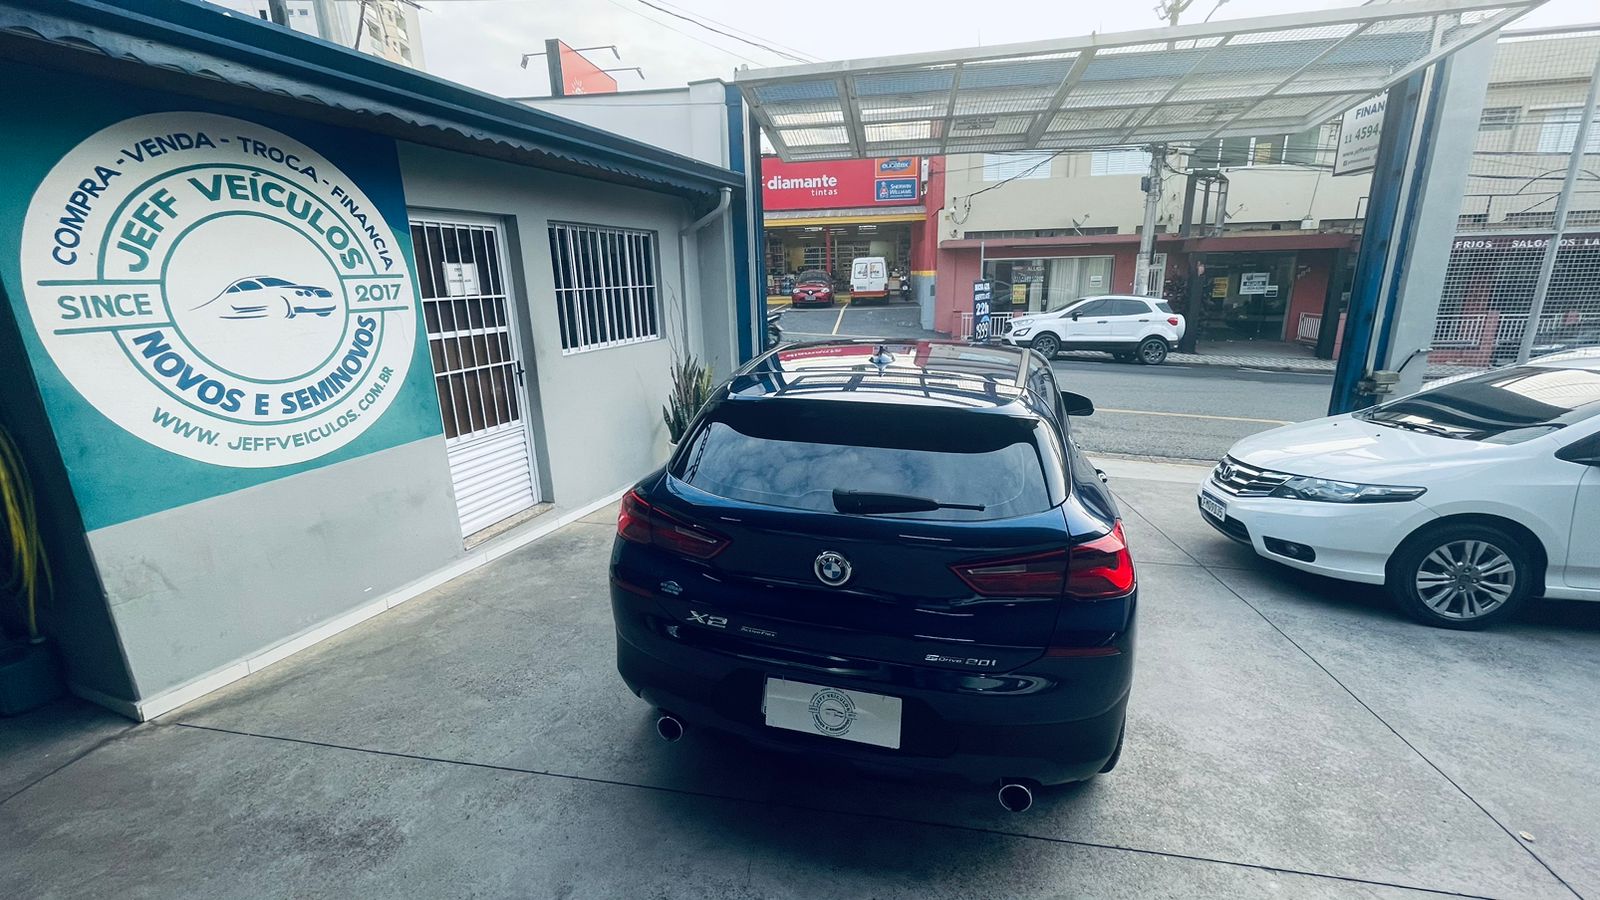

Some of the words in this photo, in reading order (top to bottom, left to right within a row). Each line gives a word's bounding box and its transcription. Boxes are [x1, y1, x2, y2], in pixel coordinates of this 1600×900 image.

[767, 174, 838, 190] diamante
[52, 165, 122, 266] COMPRA
[120, 132, 217, 163] VENDA
[236, 136, 318, 183] TROCA
[330, 185, 393, 271] FINANCIA
[811, 188, 838, 196] tintas
[117, 187, 179, 272] JEFF
[187, 172, 364, 270] VEÍCULOS
[1454, 240, 1493, 249] FRIOS
[1511, 238, 1576, 248] SALGAOS
[354, 284, 402, 302] 2017
[57, 293, 153, 320] SINCE
[132, 330, 246, 412] NOVOS
[254, 393, 270, 416] E
[280, 315, 377, 415] SEMINOVOS
[686, 610, 728, 629] X2
